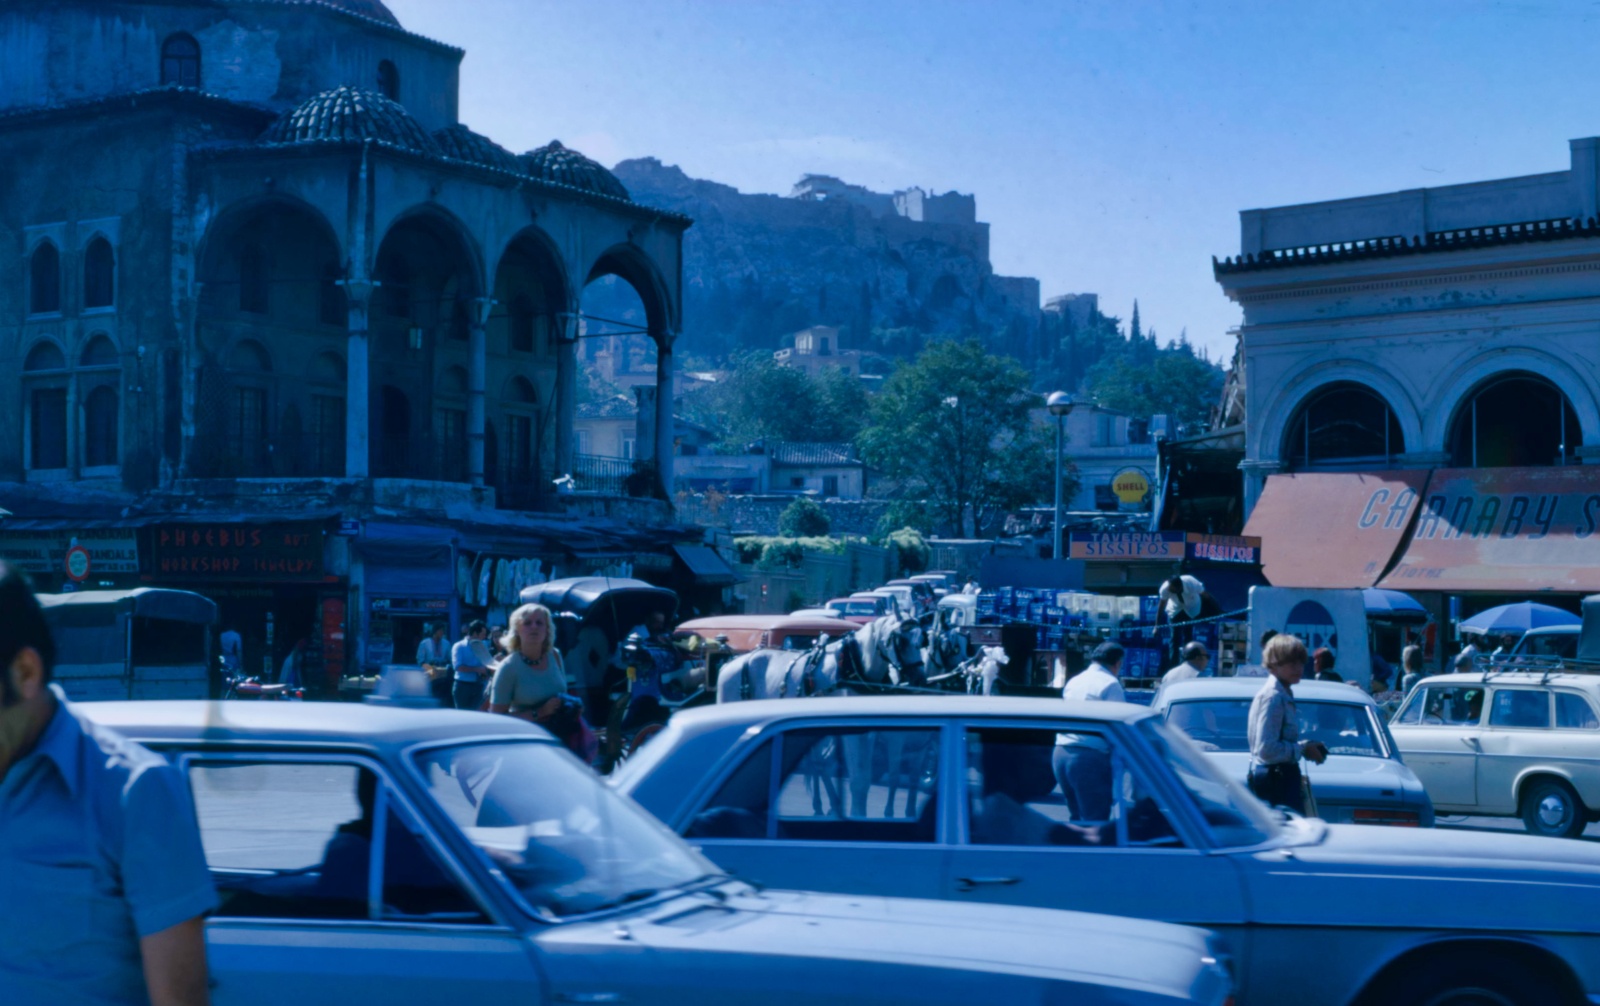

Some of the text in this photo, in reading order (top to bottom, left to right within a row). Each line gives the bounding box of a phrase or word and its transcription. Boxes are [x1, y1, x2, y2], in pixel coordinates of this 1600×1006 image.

[1116, 482, 1145, 492] SHELL
[1357, 487, 1560, 540] CARNABY
[160, 528, 262, 547] PHOEBUS
[1091, 532, 1163, 543] TAVERNA
[161, 557, 240, 572] WORKSHOP
